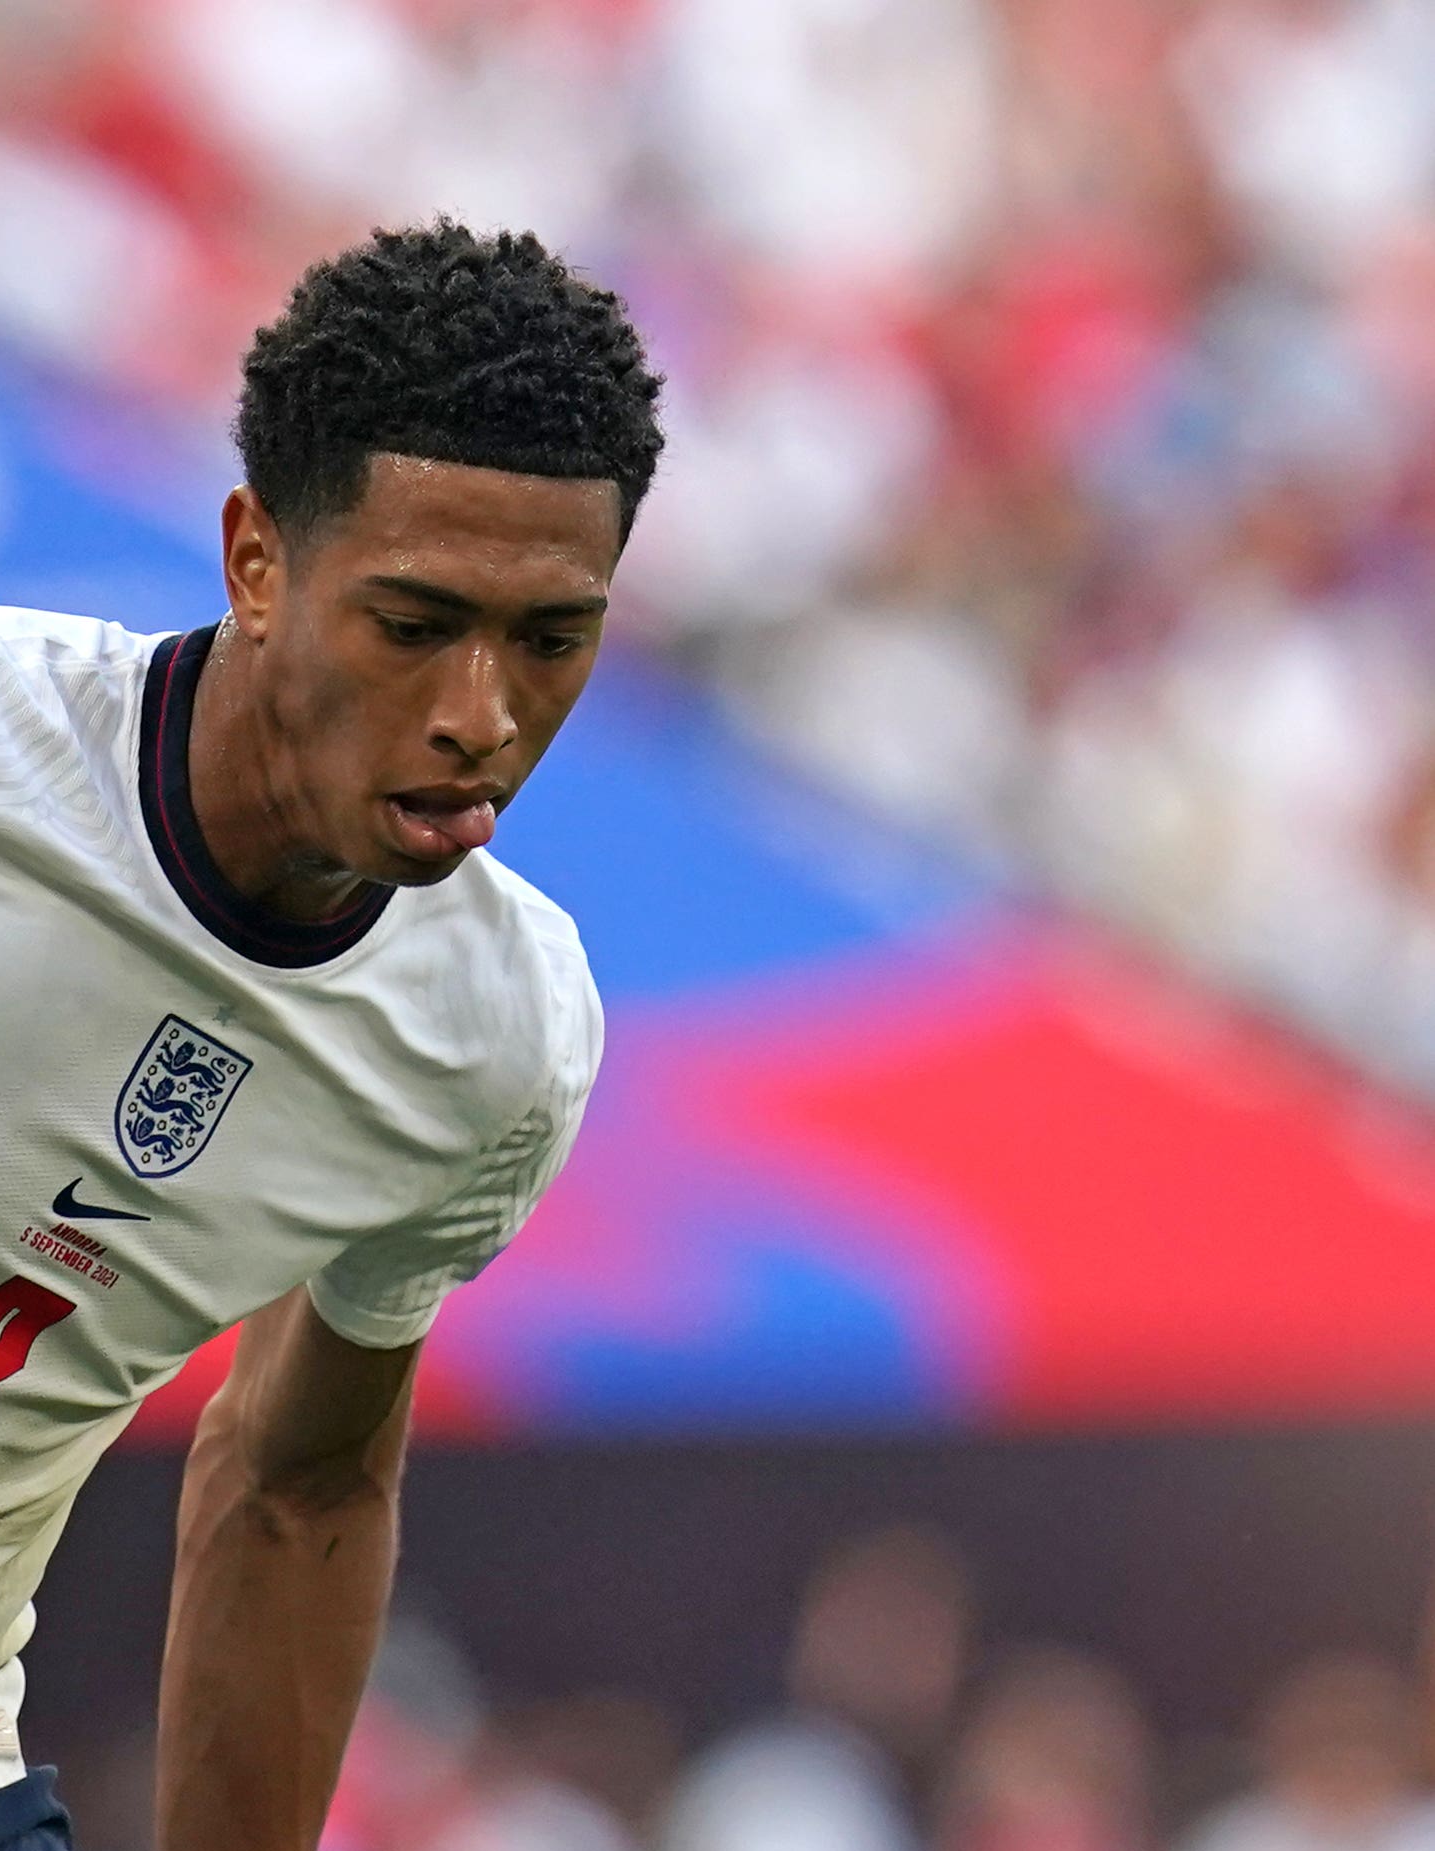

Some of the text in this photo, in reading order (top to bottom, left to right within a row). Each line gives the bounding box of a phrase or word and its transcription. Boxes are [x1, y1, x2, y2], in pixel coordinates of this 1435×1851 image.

[19, 1226, 120, 1289] 5 SEPTEMBER 2021
[49, 1222, 108, 1258] ANDORRA
